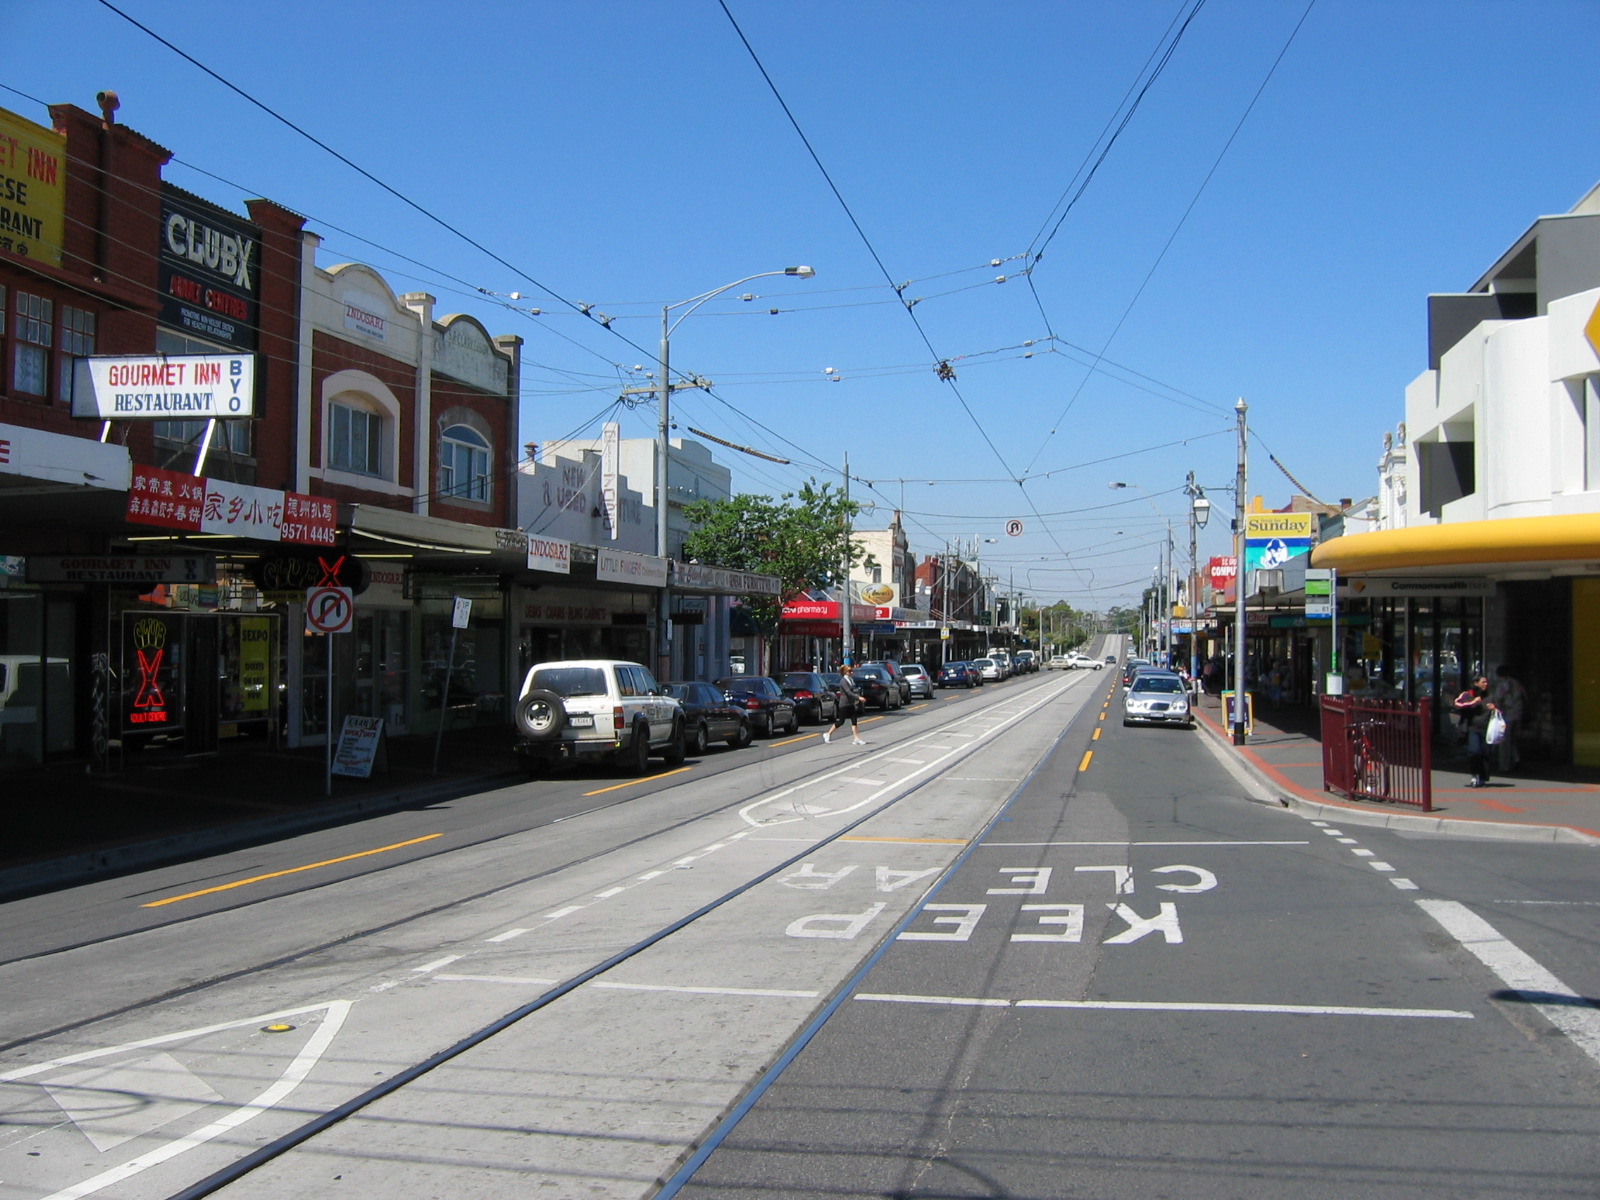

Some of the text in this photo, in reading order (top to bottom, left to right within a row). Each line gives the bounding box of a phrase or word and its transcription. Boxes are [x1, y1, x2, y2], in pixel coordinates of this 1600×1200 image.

[28, 146, 58, 187] INN
[169, 274, 248, 320] ADULT CENTRES
[346, 304, 386, 330] INDOSARI
[108, 362, 221, 387] GOURMET INN
[114, 391, 213, 413] RESTAURANT
[203, 491, 283, 531] 家乡小吃
[281, 522, 335, 544] 9571 4445
[1248, 518, 1309, 533] Sunday
[529, 539, 569, 561] INDOSARI
[61, 558, 171, 570] GOURMET INN
[67, 570, 165, 581] RESTAURANT
[1391, 581, 1468, 593] Commonwealth
[797, 605, 828, 615] pharmacy
[242, 629, 268, 642] SEXPO
[777, 863, 1218, 896] CLEAR
[785, 901, 1184, 944] KEEP
